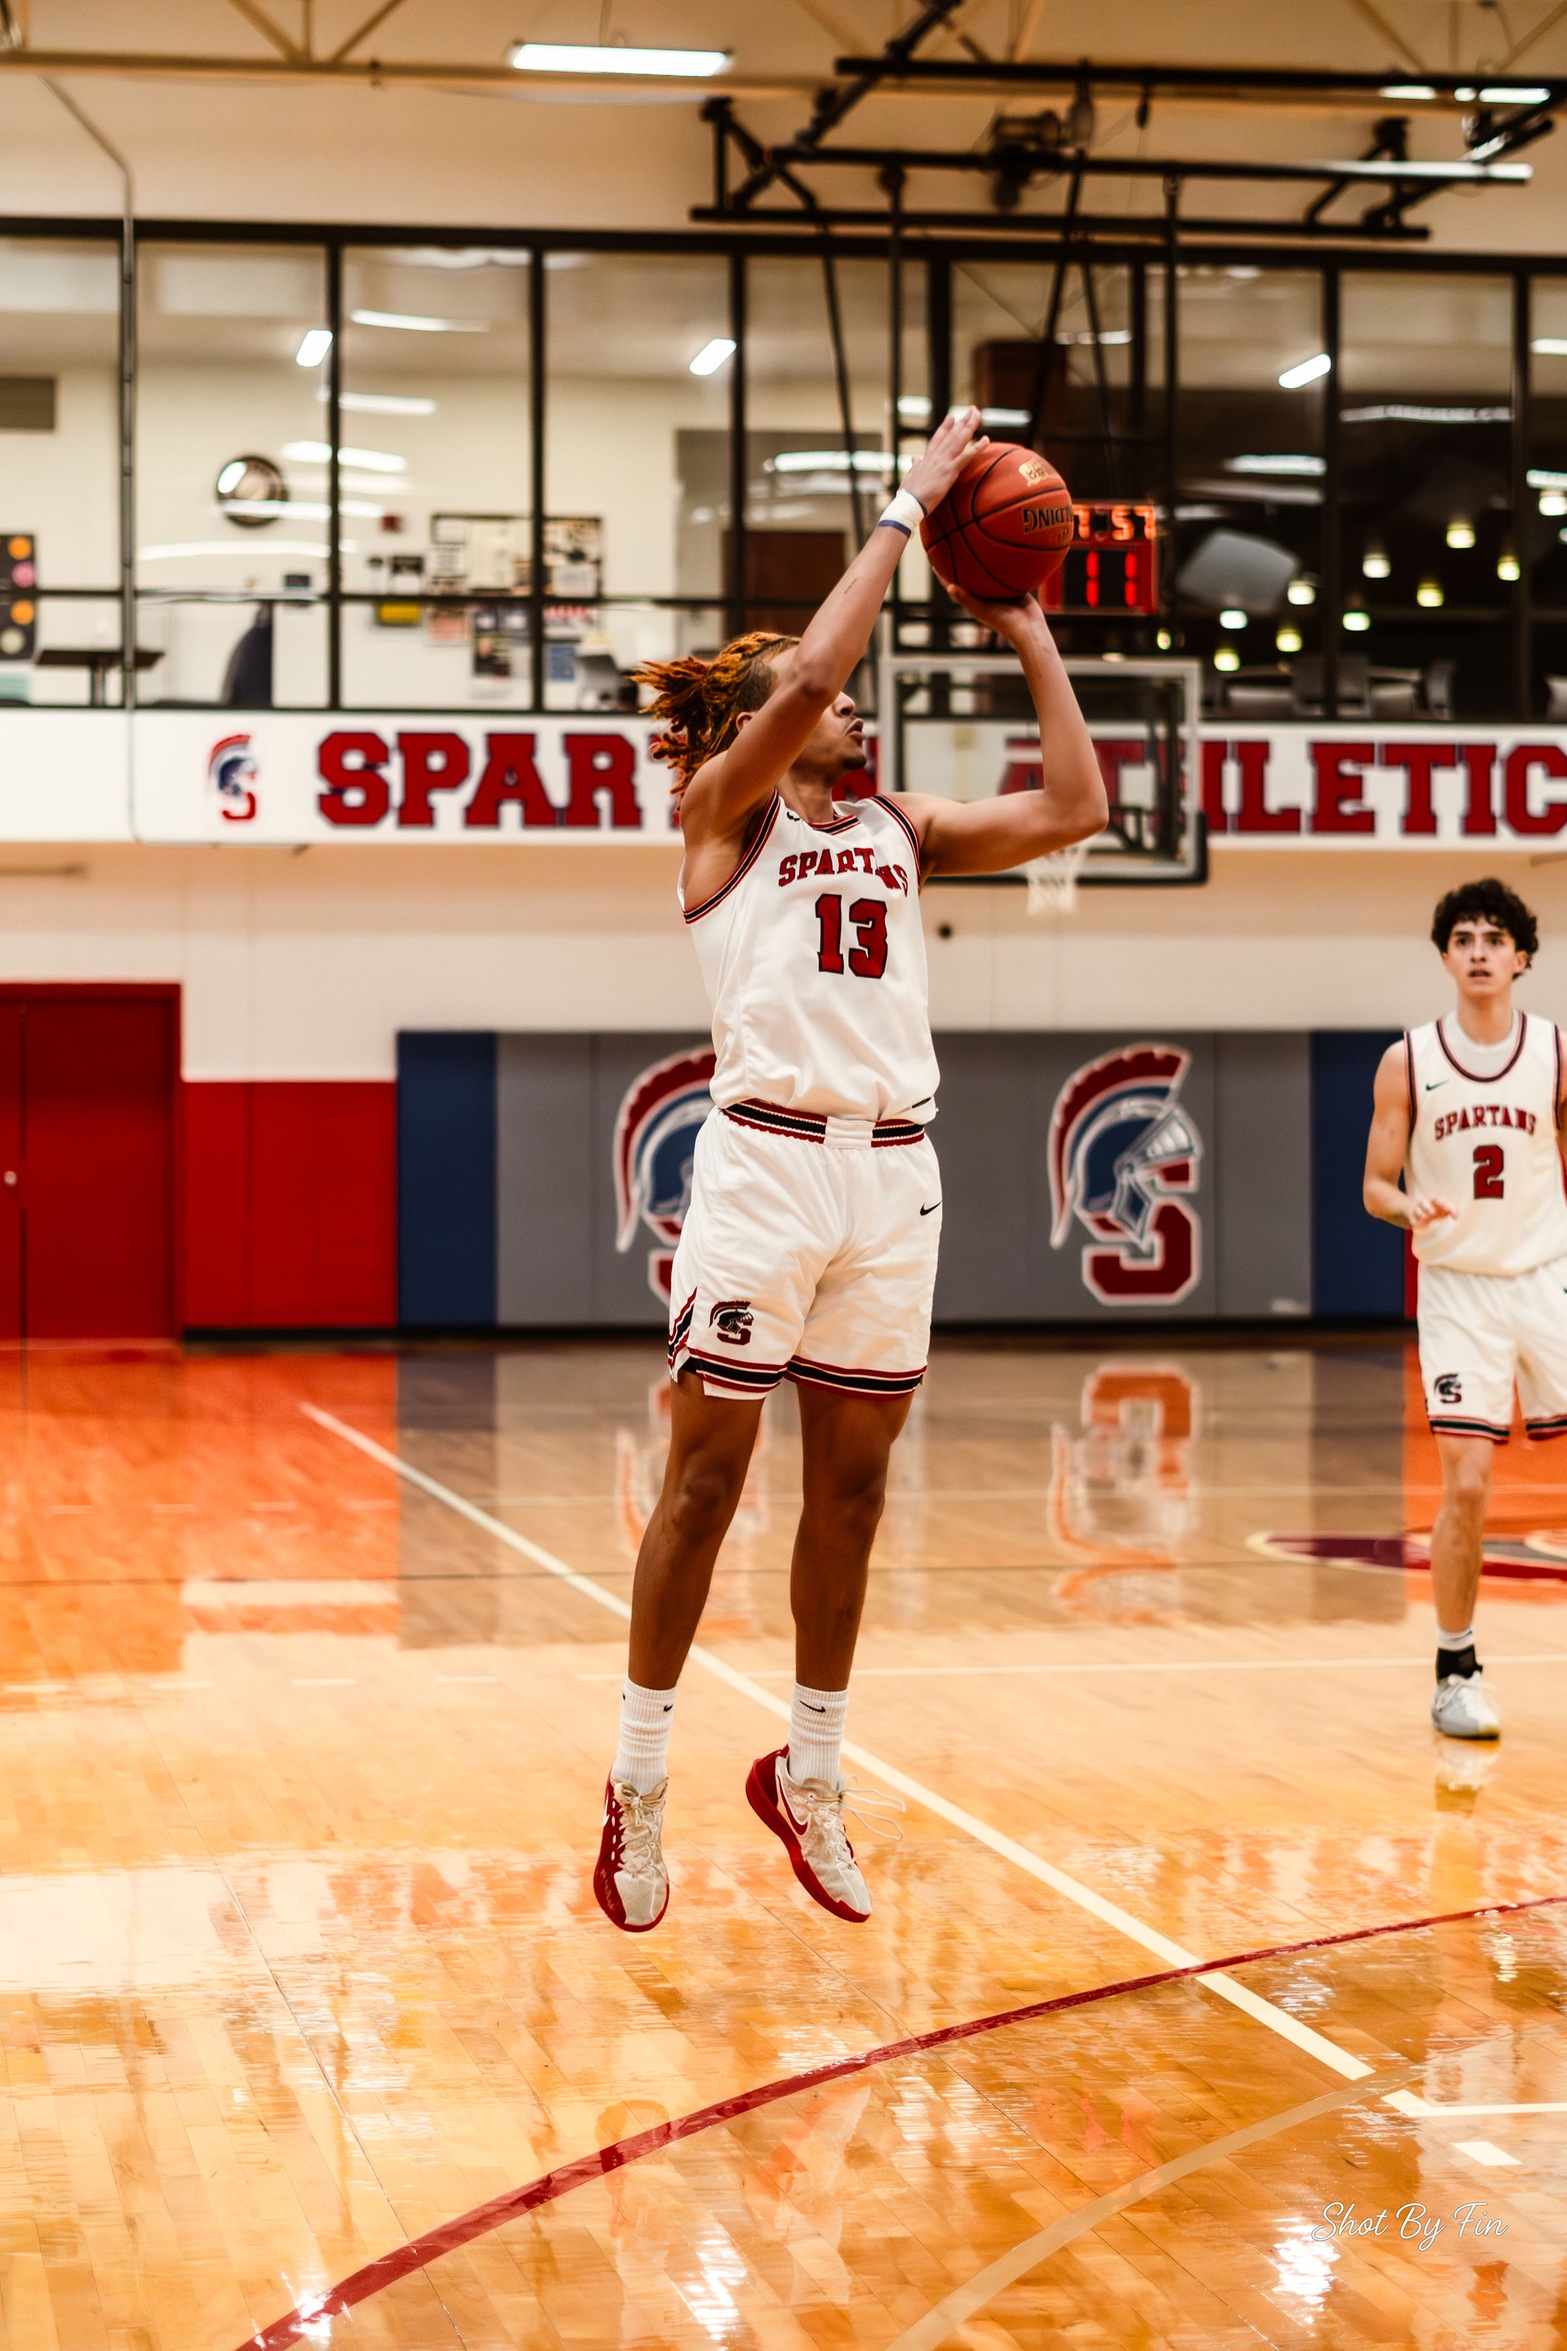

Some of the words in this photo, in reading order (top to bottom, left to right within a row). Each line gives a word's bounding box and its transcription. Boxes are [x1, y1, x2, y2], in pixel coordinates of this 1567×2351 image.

[318, 731, 878, 829] SPAR
[778, 847, 909, 898] SPARTNS
[815, 893, 889, 980] 13
[1434, 1104, 1537, 1141] SPARTANS
[1472, 1144, 1504, 1200] 2
